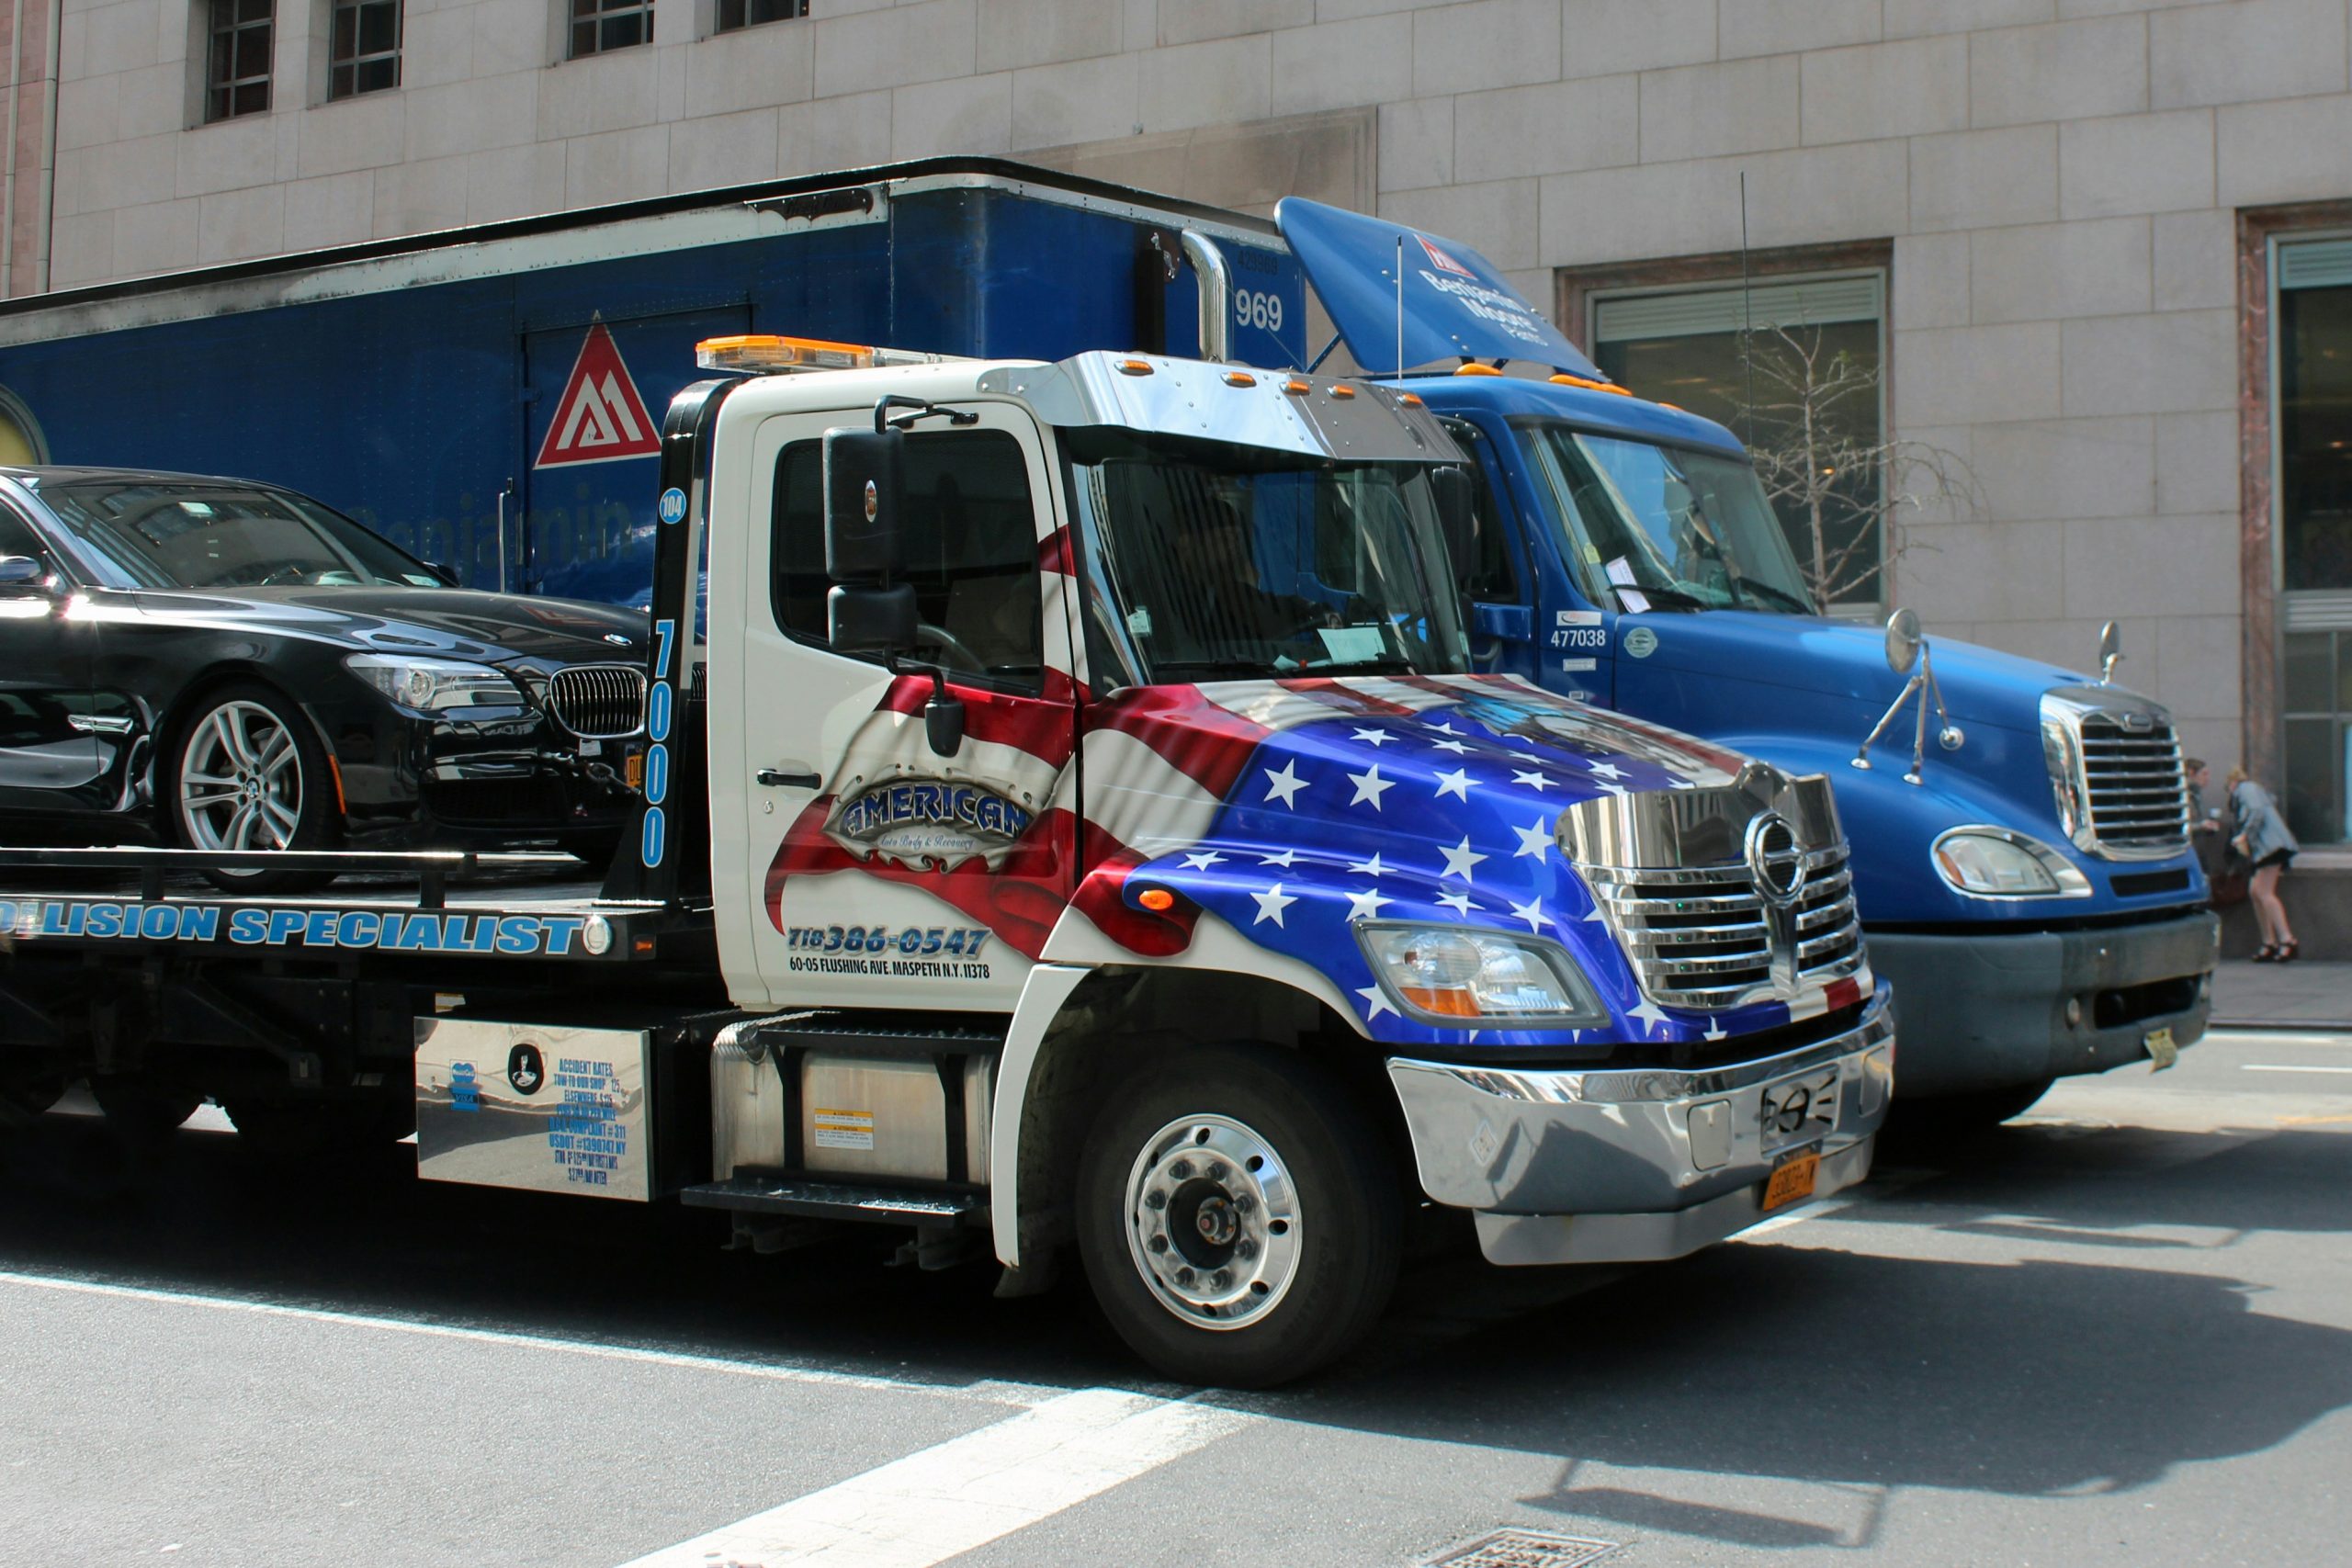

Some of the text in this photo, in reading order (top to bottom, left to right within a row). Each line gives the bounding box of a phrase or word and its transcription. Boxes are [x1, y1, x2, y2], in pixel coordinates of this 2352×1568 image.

[1419, 270, 1528, 314] Benjamin
[1236, 288, 1283, 332] 969
[1459, 297, 1539, 332] Moore
[662, 495, 683, 517] 104
[1551, 629, 1606, 647] 477038
[641, 619, 675, 868] 7000
[841, 783, 1028, 838] AMERICAN
[900, 835, 922, 850] Body
[229, 908, 584, 954] SPECIALIST
[790, 956, 819, 972] 60-05
[820, 958, 867, 975] FLUSHING
[870, 961, 892, 976] AVE.
[893, 962, 942, 977] MASPETH
[964, 964, 990, 979] 11378
[559, 1058, 614, 1077] ACCIDENT RATES
[455, 1094, 474, 1102] VISA
[549, 1134, 574, 1149] USDOT
[614, 1123, 627, 1139] 311
